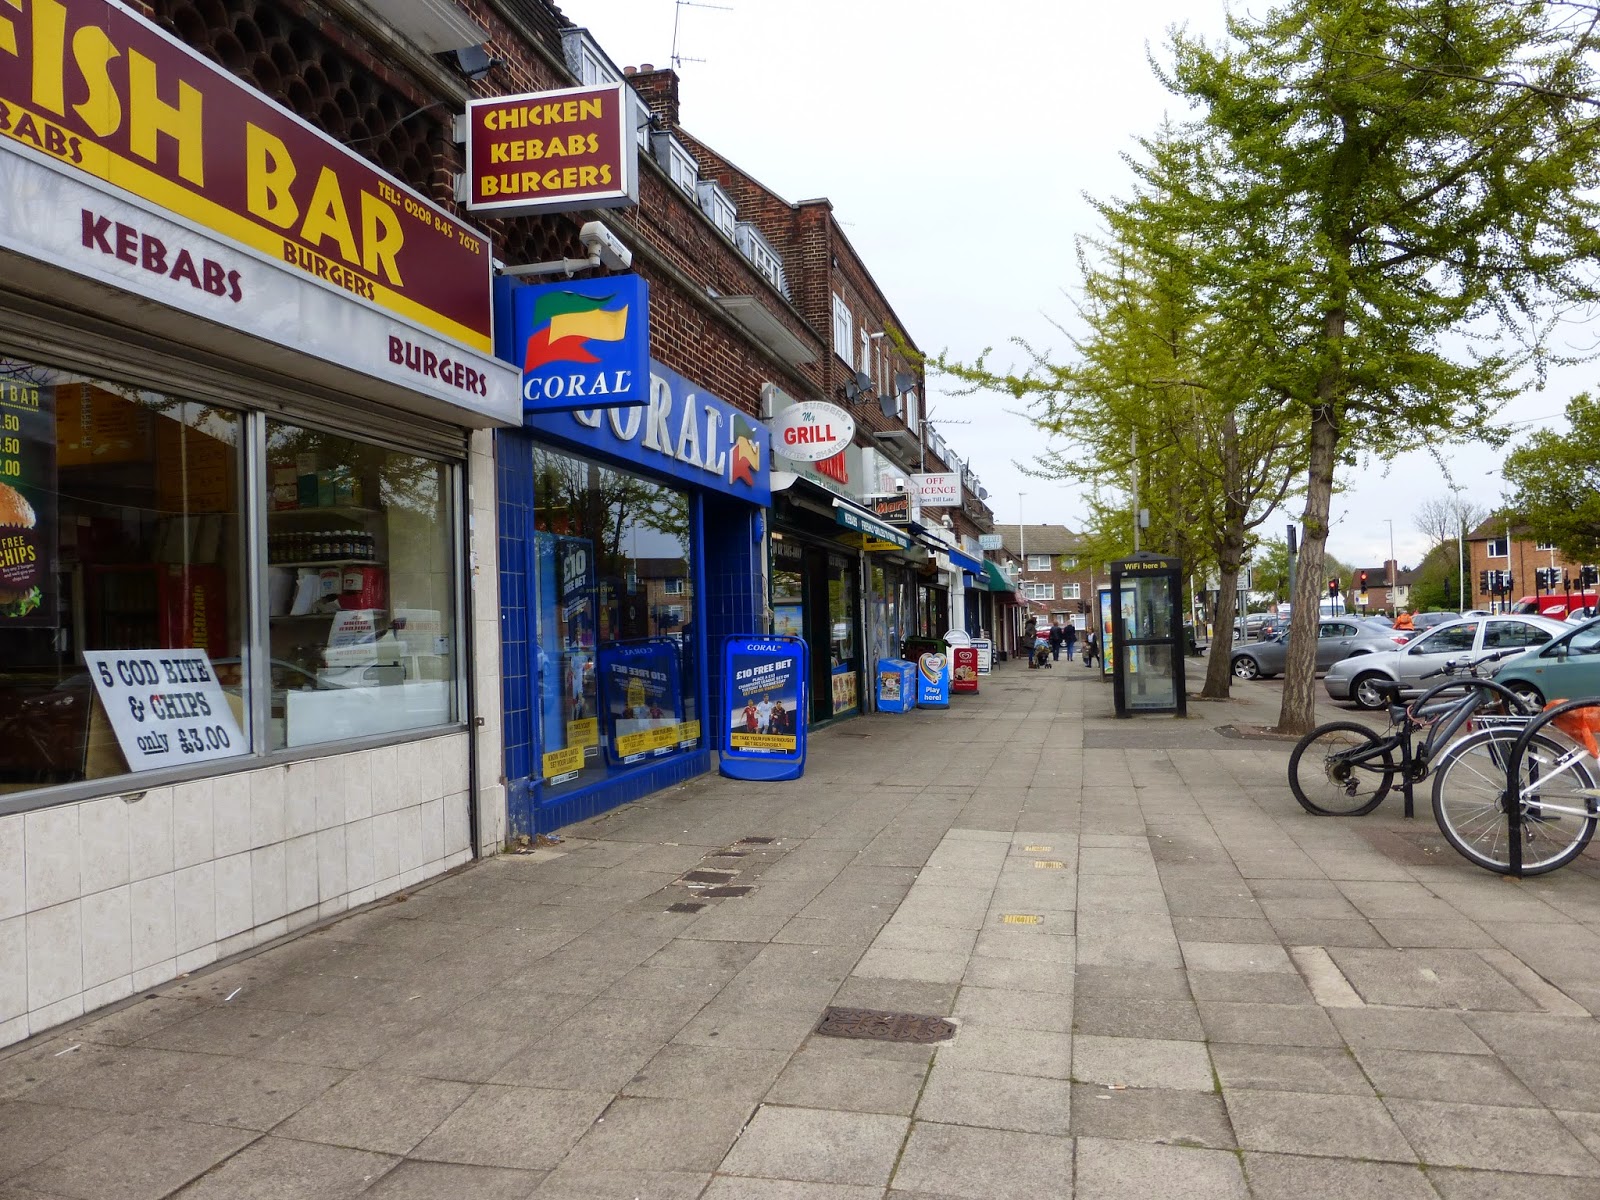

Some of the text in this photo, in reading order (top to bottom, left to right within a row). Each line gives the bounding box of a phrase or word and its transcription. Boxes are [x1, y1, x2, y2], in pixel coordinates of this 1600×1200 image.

[483, 98, 602, 131] CHICKEN
[491, 132, 599, 164] KEBABS
[481, 163, 612, 197] BURGERS
[246, 121, 404, 287] BAR
[378, 181, 480, 255] TEL: 0208 845 7675
[81, 208, 243, 304] KEBABS
[283, 239, 375, 302] BURGERS
[388, 334, 487, 398] BURGERS
[10, 384, 39, 406] BAR
[523, 370, 631, 400] CORAL
[783, 424, 836, 445] GRILL
[920, 486, 956, 495] ICENCE
[926, 477, 945, 485] OFF
[876, 500, 908, 514] Mars
[2, 536, 25, 549] FREE
[563, 549, 586, 584] £10
[747, 644, 777, 652] CORAL
[97, 658, 211, 688] 5 COD BITE
[736, 658, 793, 680] £10 FREE BET
[926, 687, 940, 695] Play
[128, 692, 212, 723] & CHIPS
[137, 725, 231, 754] only £3.00
